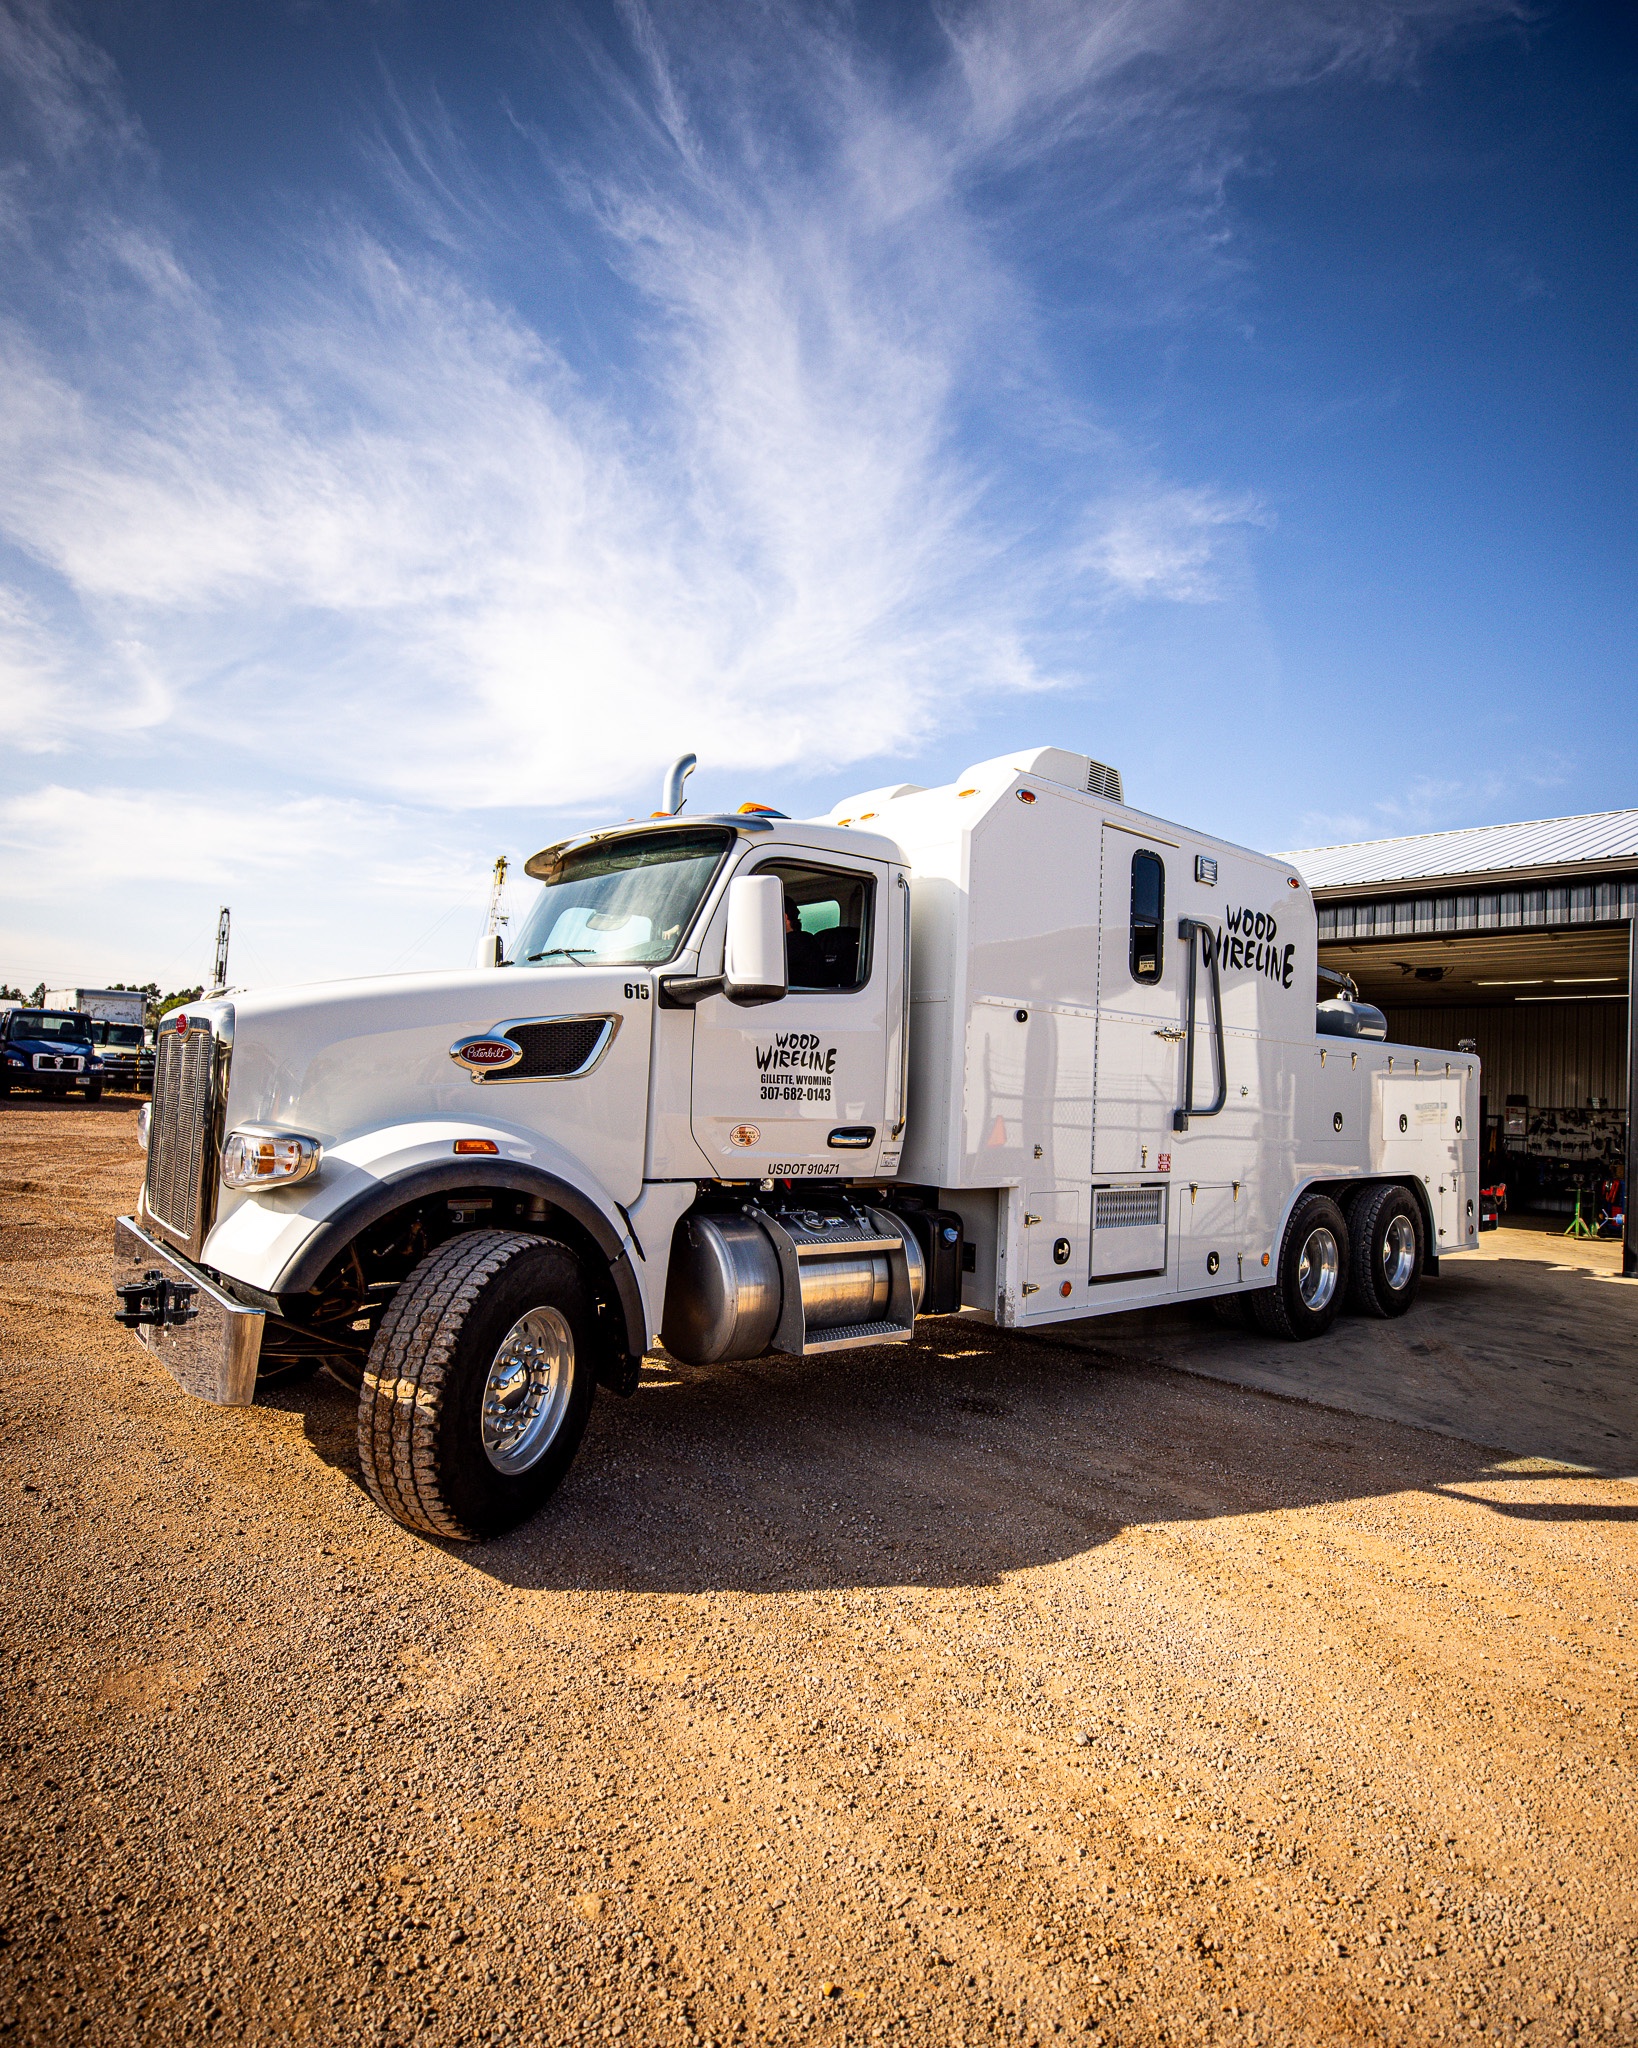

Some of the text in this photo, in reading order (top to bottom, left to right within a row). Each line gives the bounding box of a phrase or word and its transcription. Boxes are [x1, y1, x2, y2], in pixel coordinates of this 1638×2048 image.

[1226, 904, 1277, 943] WOOD
[1202, 925, 1295, 989] WIRELINE
[624, 983, 650, 1000] 615
[775, 1033, 820, 1050] WOOD
[466, 1047, 509, 1058] Peterbilt
[756, 1045, 837, 1074] WIRELINE
[760, 1074, 832, 1086] GILLETTE, WYOMING
[760, 1086, 831, 1101] 307-682-0143
[767, 1163, 840, 1175] USDOT 910471
